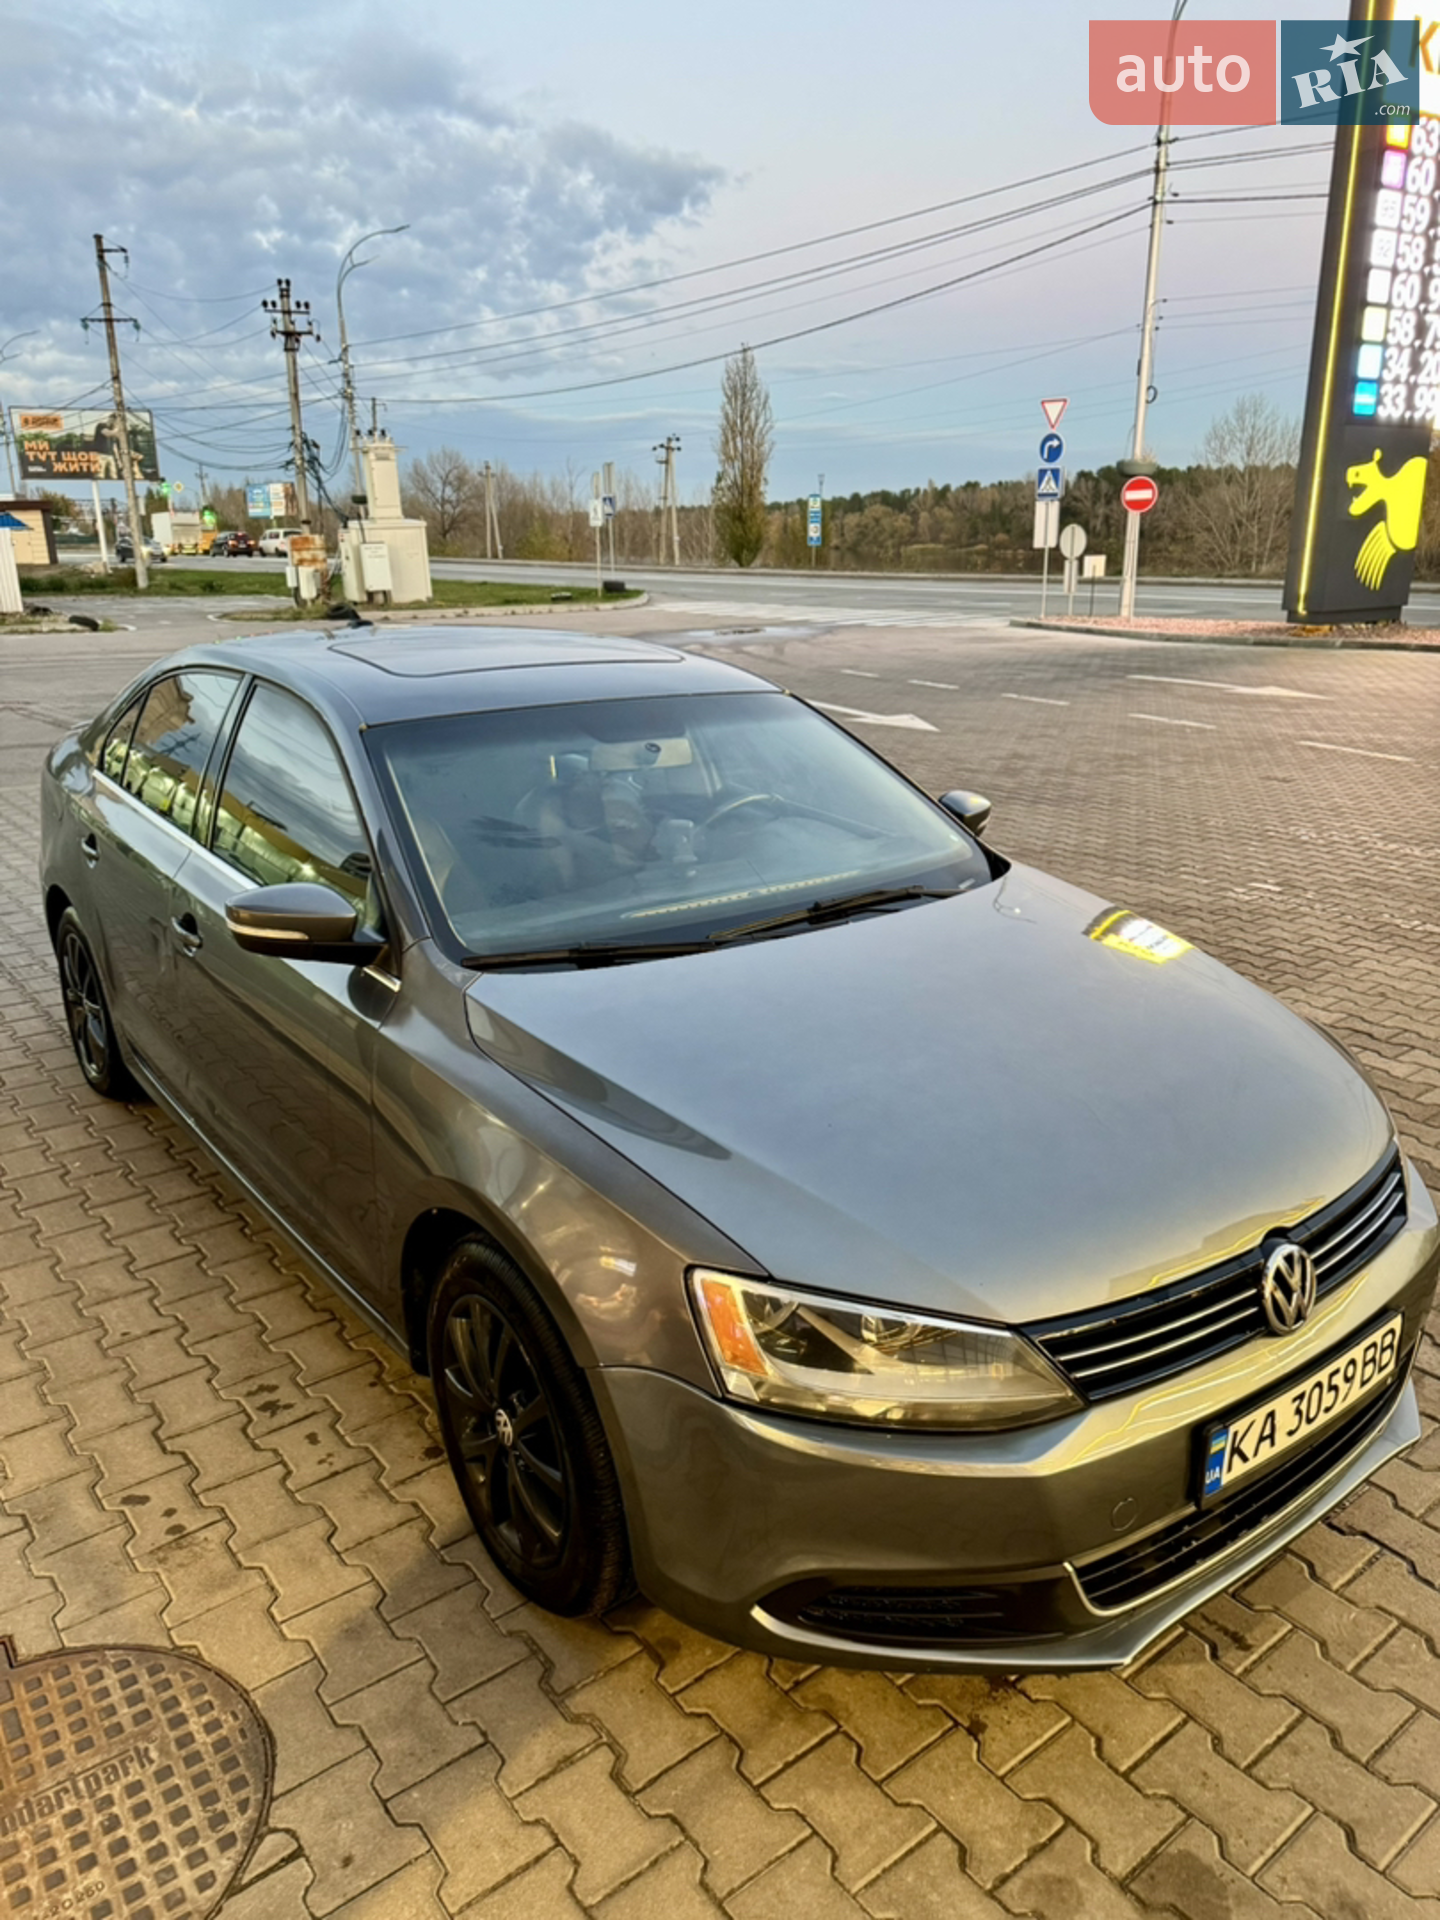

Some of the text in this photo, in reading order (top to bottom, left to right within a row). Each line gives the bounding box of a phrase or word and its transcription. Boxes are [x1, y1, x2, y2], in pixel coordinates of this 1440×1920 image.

[1226, 1327, 1397, 1474] KA 3059 BB
[1205, 1466, 1221, 1484] UA
